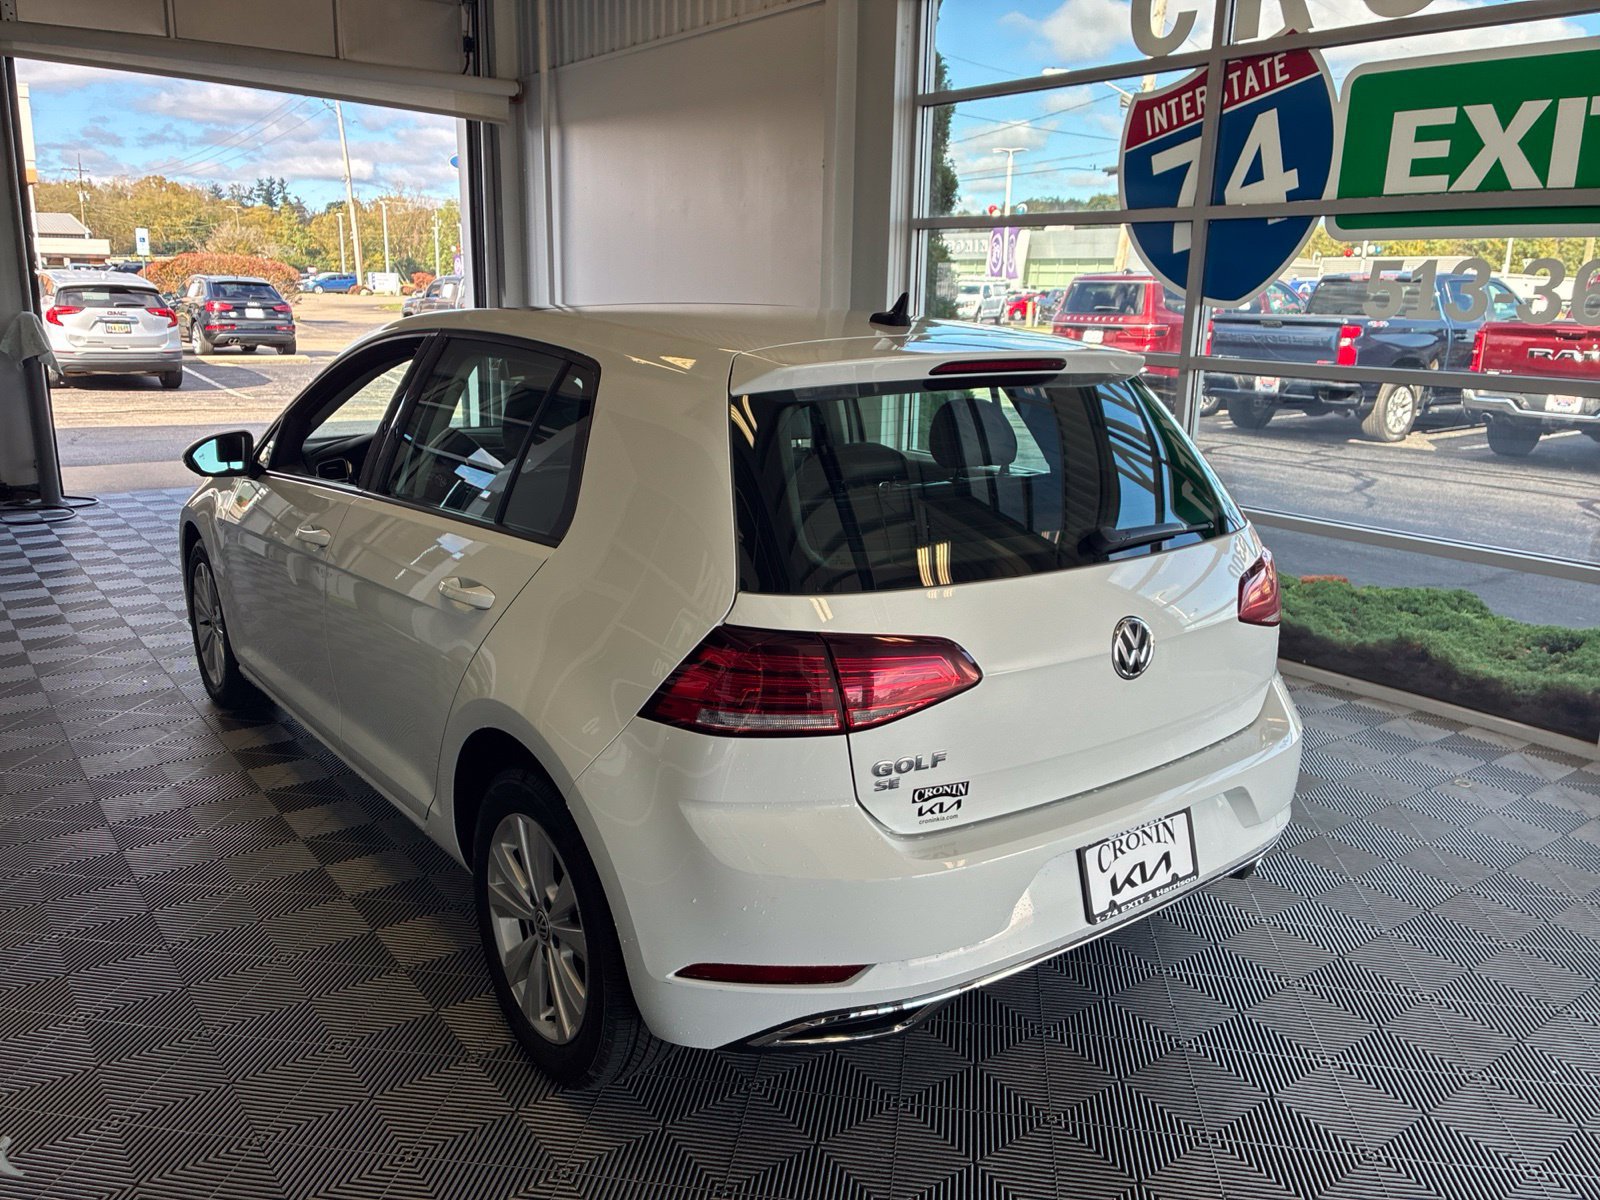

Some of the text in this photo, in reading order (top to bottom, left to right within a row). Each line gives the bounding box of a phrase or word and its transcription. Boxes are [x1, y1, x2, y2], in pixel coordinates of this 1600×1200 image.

[1145, 52, 1291, 136] INTERTATE
[1383, 96, 1600, 195] EXI
[1151, 107, 1299, 254] 74
[871, 750, 947, 777] GOLF
[874, 776, 900, 792] SE
[913, 782, 968, 803] CRONIN
[918, 814, 959, 825] croninkia.com
[1097, 818, 1176, 874] CRONIN
[1095, 909, 1119, 924] I-74
[1121, 897, 1145, 912] EXIT
[1155, 875, 1198, 898] Harrison
